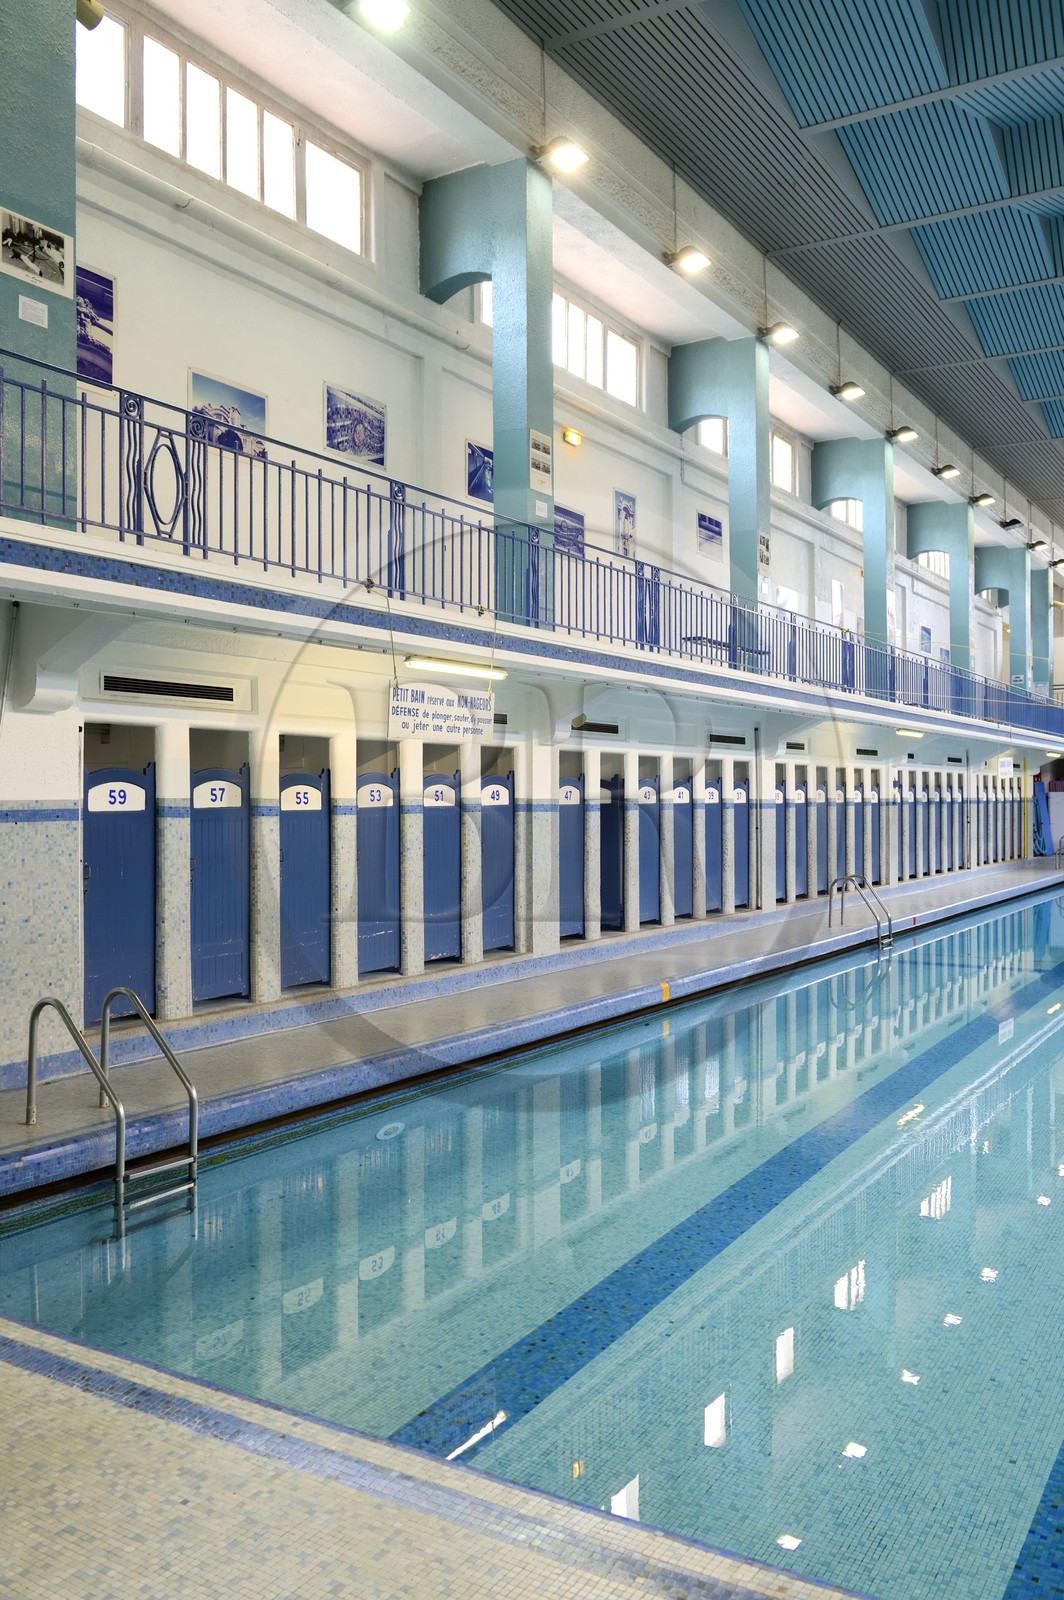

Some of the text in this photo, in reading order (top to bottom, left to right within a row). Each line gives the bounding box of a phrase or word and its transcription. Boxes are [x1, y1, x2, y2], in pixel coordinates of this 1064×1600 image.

[392, 687, 492, 712] PETIT BAIN réservé aux NON-NAGEURS
[391, 705, 420, 718] DÉFENSE
[421, 709, 430, 719] de
[401, 719, 484, 738] ou jeter une autre personne
[108, 789, 127, 806] 59
[210, 787, 226, 803] 57
[295, 791, 310, 806] 55
[369, 789, 382, 803] 53
[434, 789, 444, 802] 51
[490, 789, 501, 802] 49
[564, 790, 573, 801] 47
[643, 791, 651, 801] 43
[677, 791, 684, 800] 41
[708, 791, 714, 800] 39
